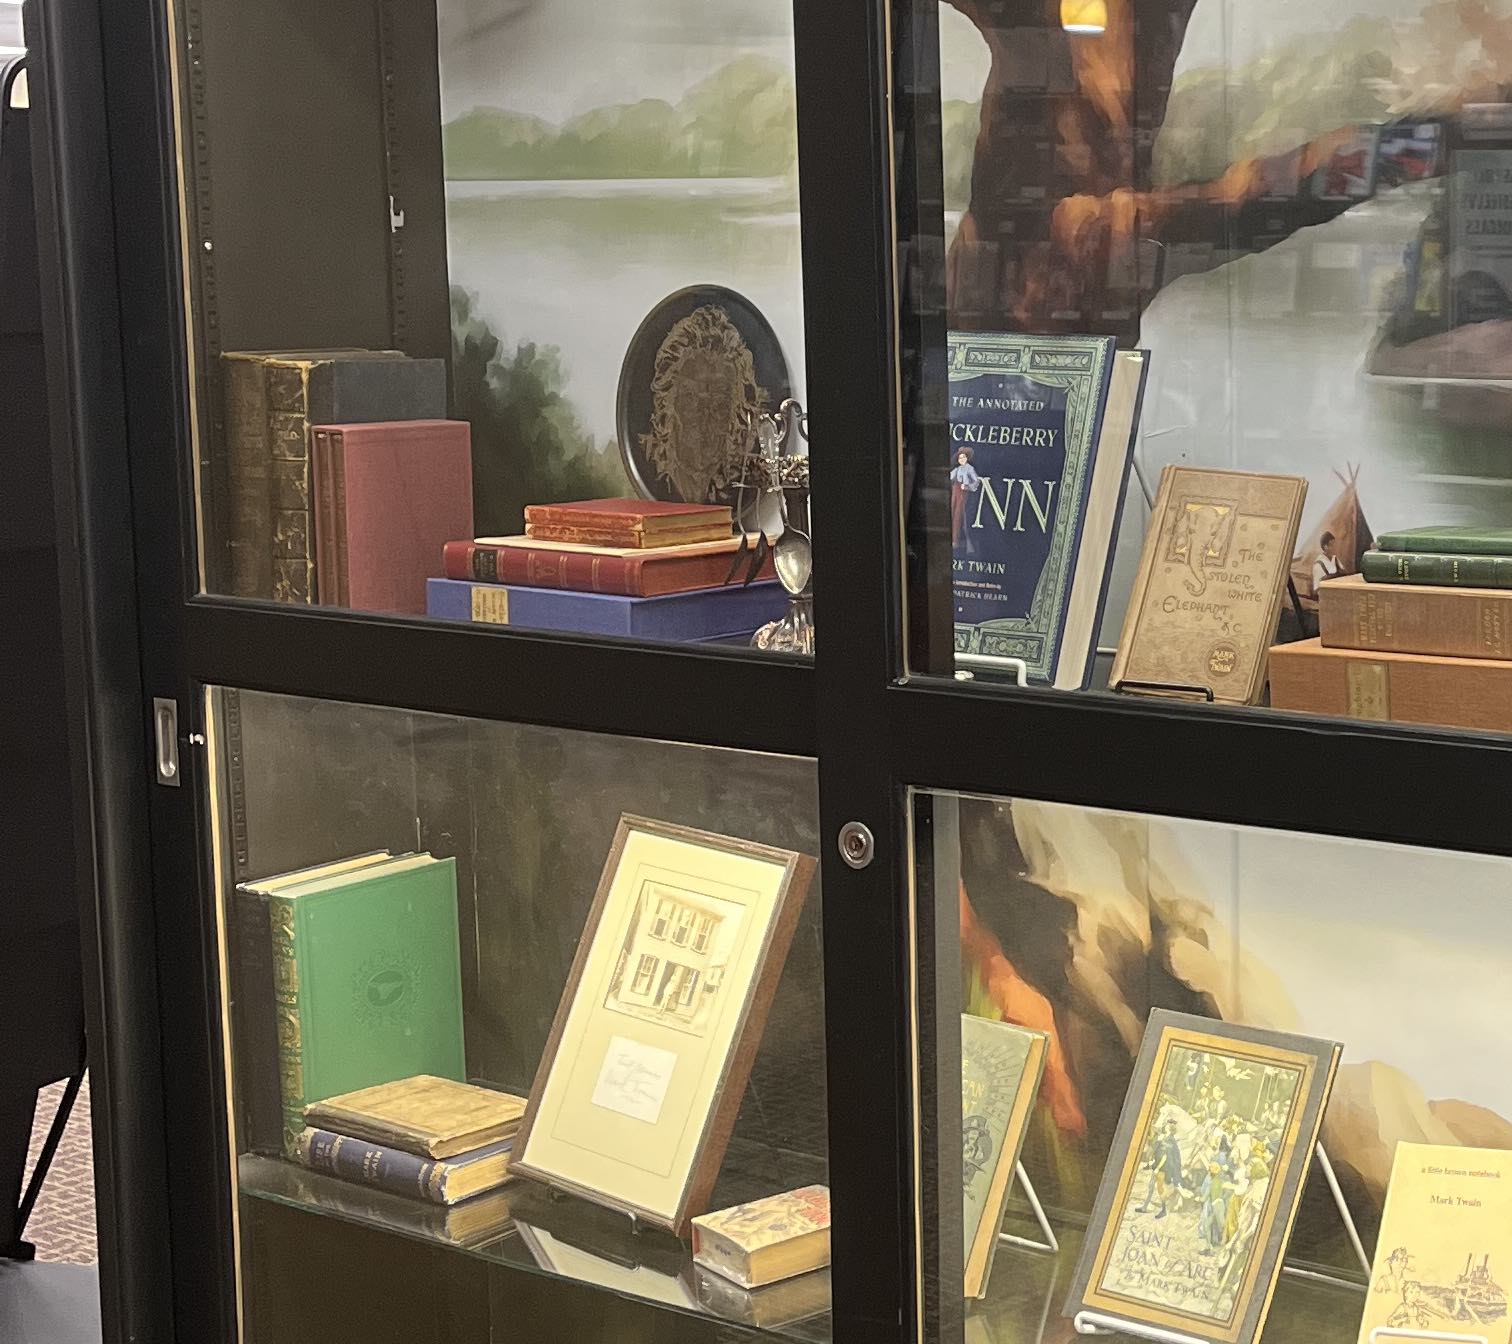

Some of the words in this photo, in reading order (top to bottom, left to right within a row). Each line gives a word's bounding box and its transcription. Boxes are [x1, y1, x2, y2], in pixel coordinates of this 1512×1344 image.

[952, 396, 974, 408] THE
[977, 397, 1045, 412] ANNOTATED
[1239, 548, 1264, 563] THE
[967, 560, 1006, 575] TWAIN
[1206, 571, 1255, 590] STOLEN
[1227, 589, 1263, 603] WHITE
[1430, 1194, 1454, 1206] Mark
[1456, 1196, 1482, 1208] Twain
[1127, 1224, 1174, 1250] SAINT
[1121, 1245, 1159, 1268] JOAN
